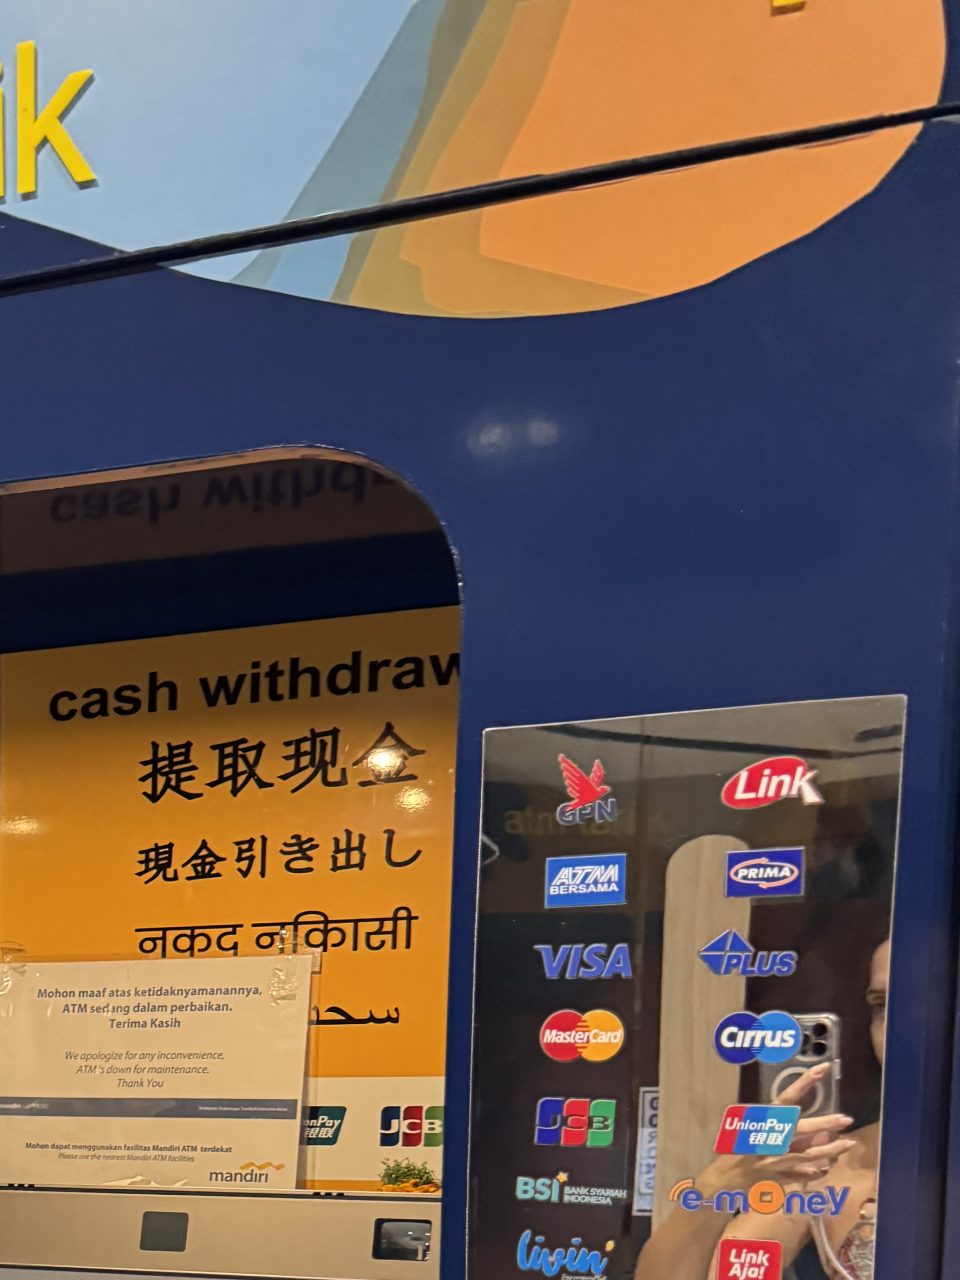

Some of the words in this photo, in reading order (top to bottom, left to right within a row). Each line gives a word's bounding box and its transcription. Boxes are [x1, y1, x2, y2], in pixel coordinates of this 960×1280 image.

[49, 671, 178, 721] cash
[138, 722, 426, 803] 提取现金
[735, 766, 824, 805] Link
[556, 798, 617, 826] GPN
[135, 829, 423, 884] 現金引き出し
[552, 864, 619, 885] ATM
[738, 865, 792, 880] PRIMA
[549, 882, 619, 895] BERSAMA
[135, 924, 244, 958] नकद
[534, 943, 633, 980] VISA
[720, 951, 797, 977] PLUS
[37, 988, 76, 998] Mohon
[78, 987, 107, 998] maaf
[108, 988, 131, 998] atas
[134, 986, 263, 998] ketidaknyamanannya,
[62, 1004, 87, 1014] ATM
[132, 1002, 168, 1013] dalam
[170, 1002, 233, 1014] perbaikan.
[109, 1018, 148, 1029] Terima
[150, 1017, 181, 1028] Kasih
[543, 1027, 623, 1046] MasterCard
[720, 1026, 796, 1049] Cirrus
[64, 1051, 79, 1060] We
[80, 1051, 123, 1063] apologize
[124, 1051, 137, 1060] for
[138, 1052, 156, 1063] any
[157, 1050, 225, 1061] inconvenience,
[76, 1065, 97, 1074] ATM
[106, 1065, 132, 1074] down
[133, 1065, 146, 1074] for
[147, 1065, 210, 1074] maintenance.
[117, 1078, 145, 1088] Thank
[146, 1078, 165, 1088] You
[380, 1119, 443, 1134] JCB
[535, 1112, 613, 1133] JCB
[725, 1117, 792, 1137] UnionPay
[748, 1132, 786, 1146] 银联
[25, 1142, 50, 1150] Mohon
[50, 1142, 71, 1151] dapat
[72, 1143, 123, 1152] menggunakan
[123, 1143, 151, 1152] fasilitas
[152, 1144, 180, 1152] Mandiri
[200, 1145, 233, 1153] terdekat
[57, 1153, 80, 1161] Please
[126, 1154, 151, 1162] Mandiri
[152, 1154, 167, 1162] ATM
[209, 1169, 269, 1183] mandiri
[563, 1194, 612, 1205] INDONESIA
[564, 1186, 589, 1196] BANK
[590, 1187, 627, 1199] SYARIAH
[729, 1248, 769, 1266] Link
[728, 1263, 765, 1280] Aja!
